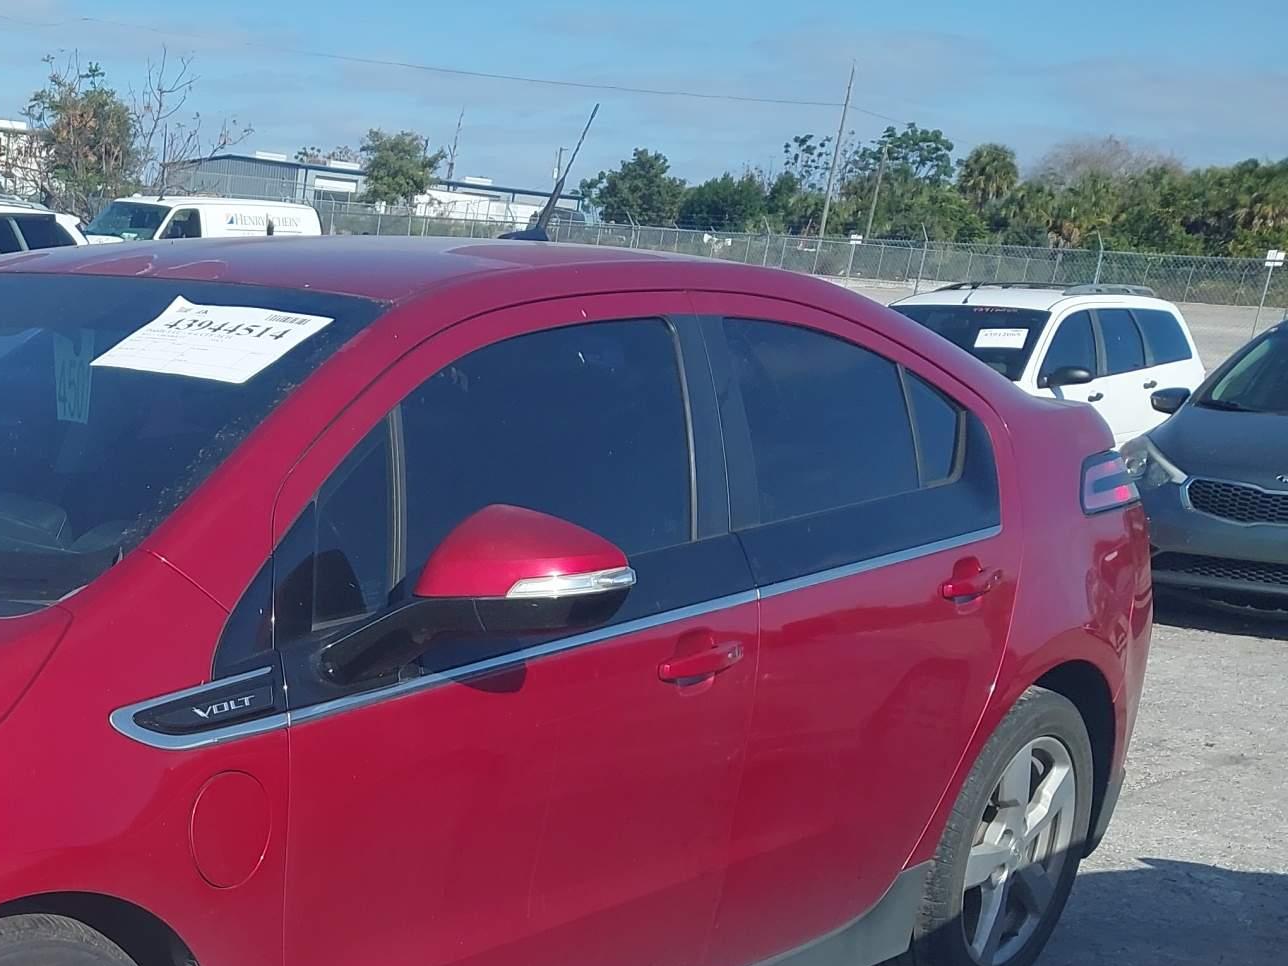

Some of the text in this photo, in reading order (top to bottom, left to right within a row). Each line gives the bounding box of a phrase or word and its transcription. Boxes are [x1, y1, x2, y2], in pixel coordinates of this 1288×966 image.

[234, 212, 299, 228] HENRY CHEIN
[164, 317, 292, 340] 43944514
[192, 695, 255, 718] VOLT
